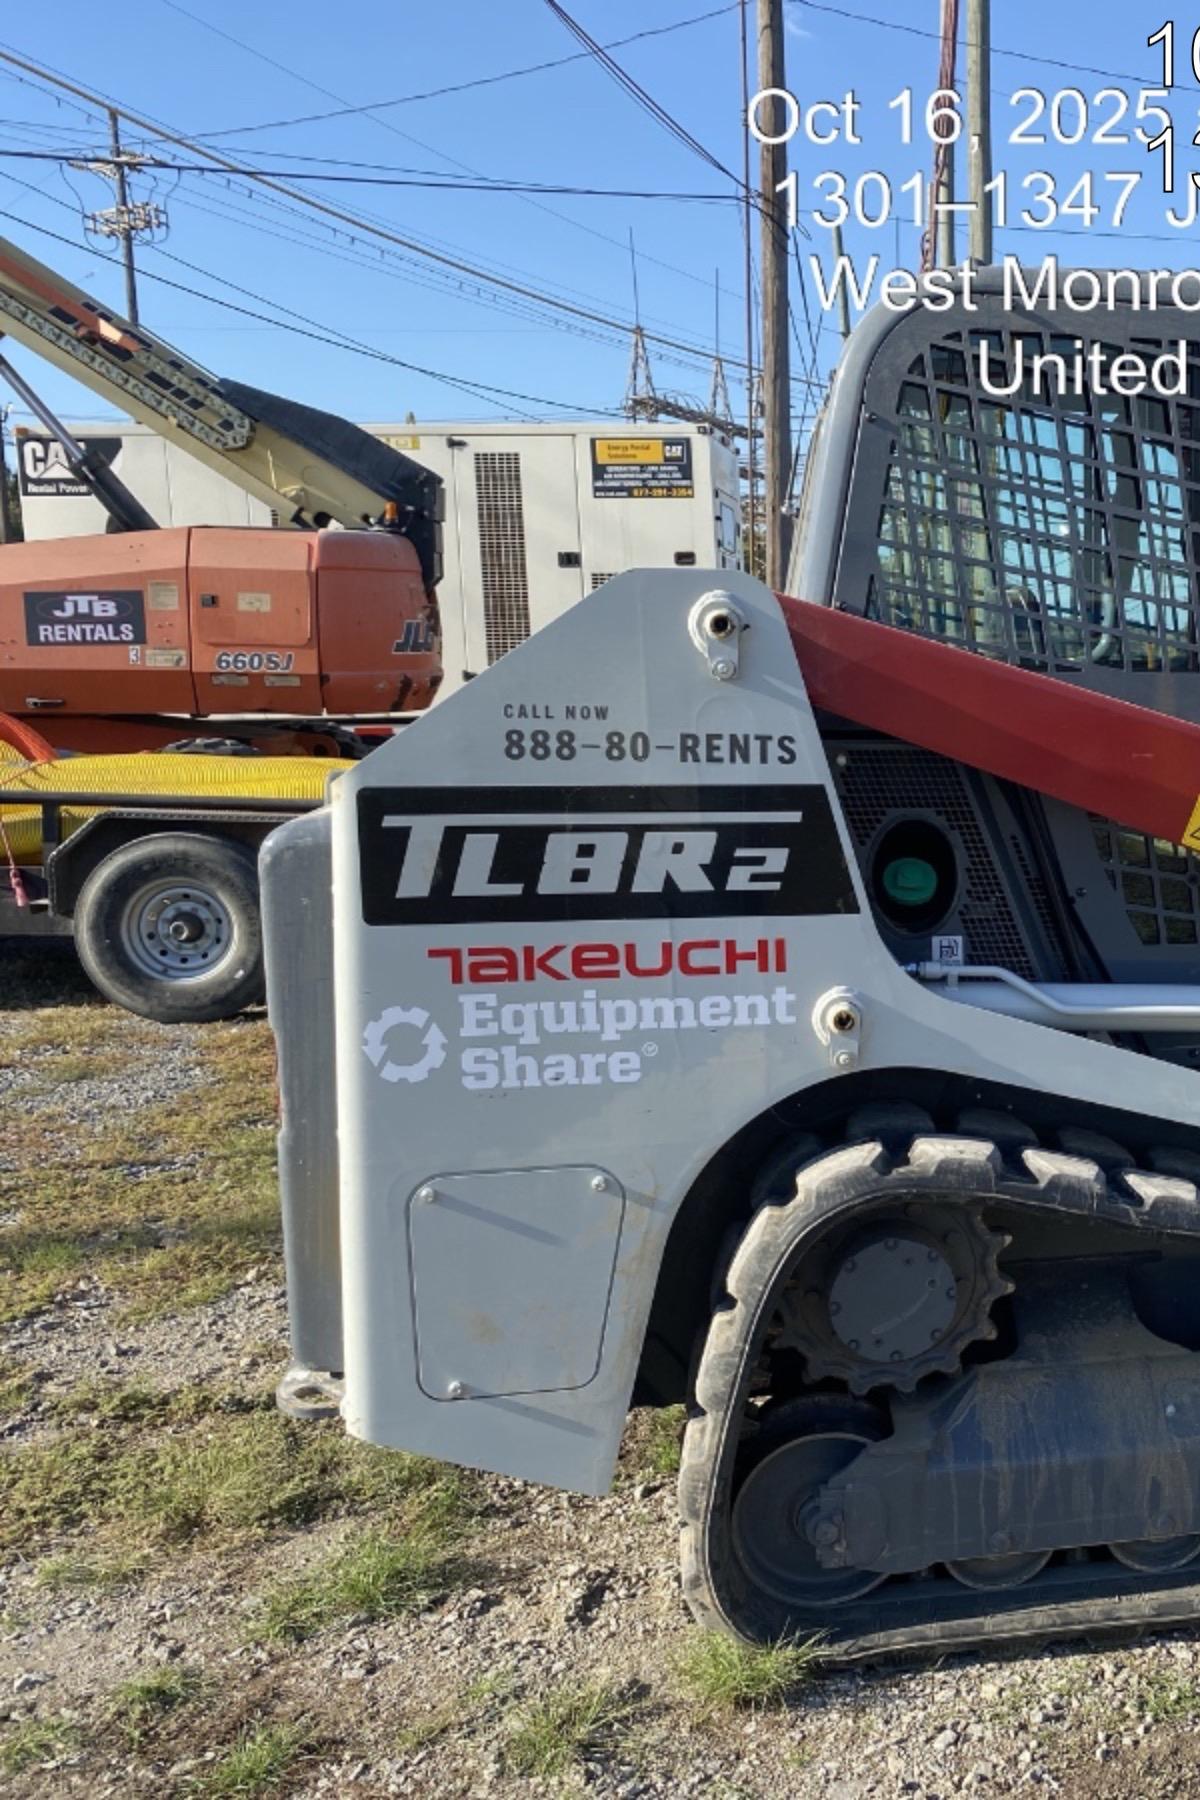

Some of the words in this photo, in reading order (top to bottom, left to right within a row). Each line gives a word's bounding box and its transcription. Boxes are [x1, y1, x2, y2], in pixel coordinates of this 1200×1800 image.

[23, 441, 88, 479] CA
[52, 596, 118, 617] JTB
[38, 624, 135, 643] RENTALS
[216, 652, 293, 672] 660SJ
[503, 703, 555, 720] CALL
[564, 705, 610, 721] NOW
[503, 728, 798, 765] 888-80-RENTS
[458, 986, 797, 1044] Equipment
